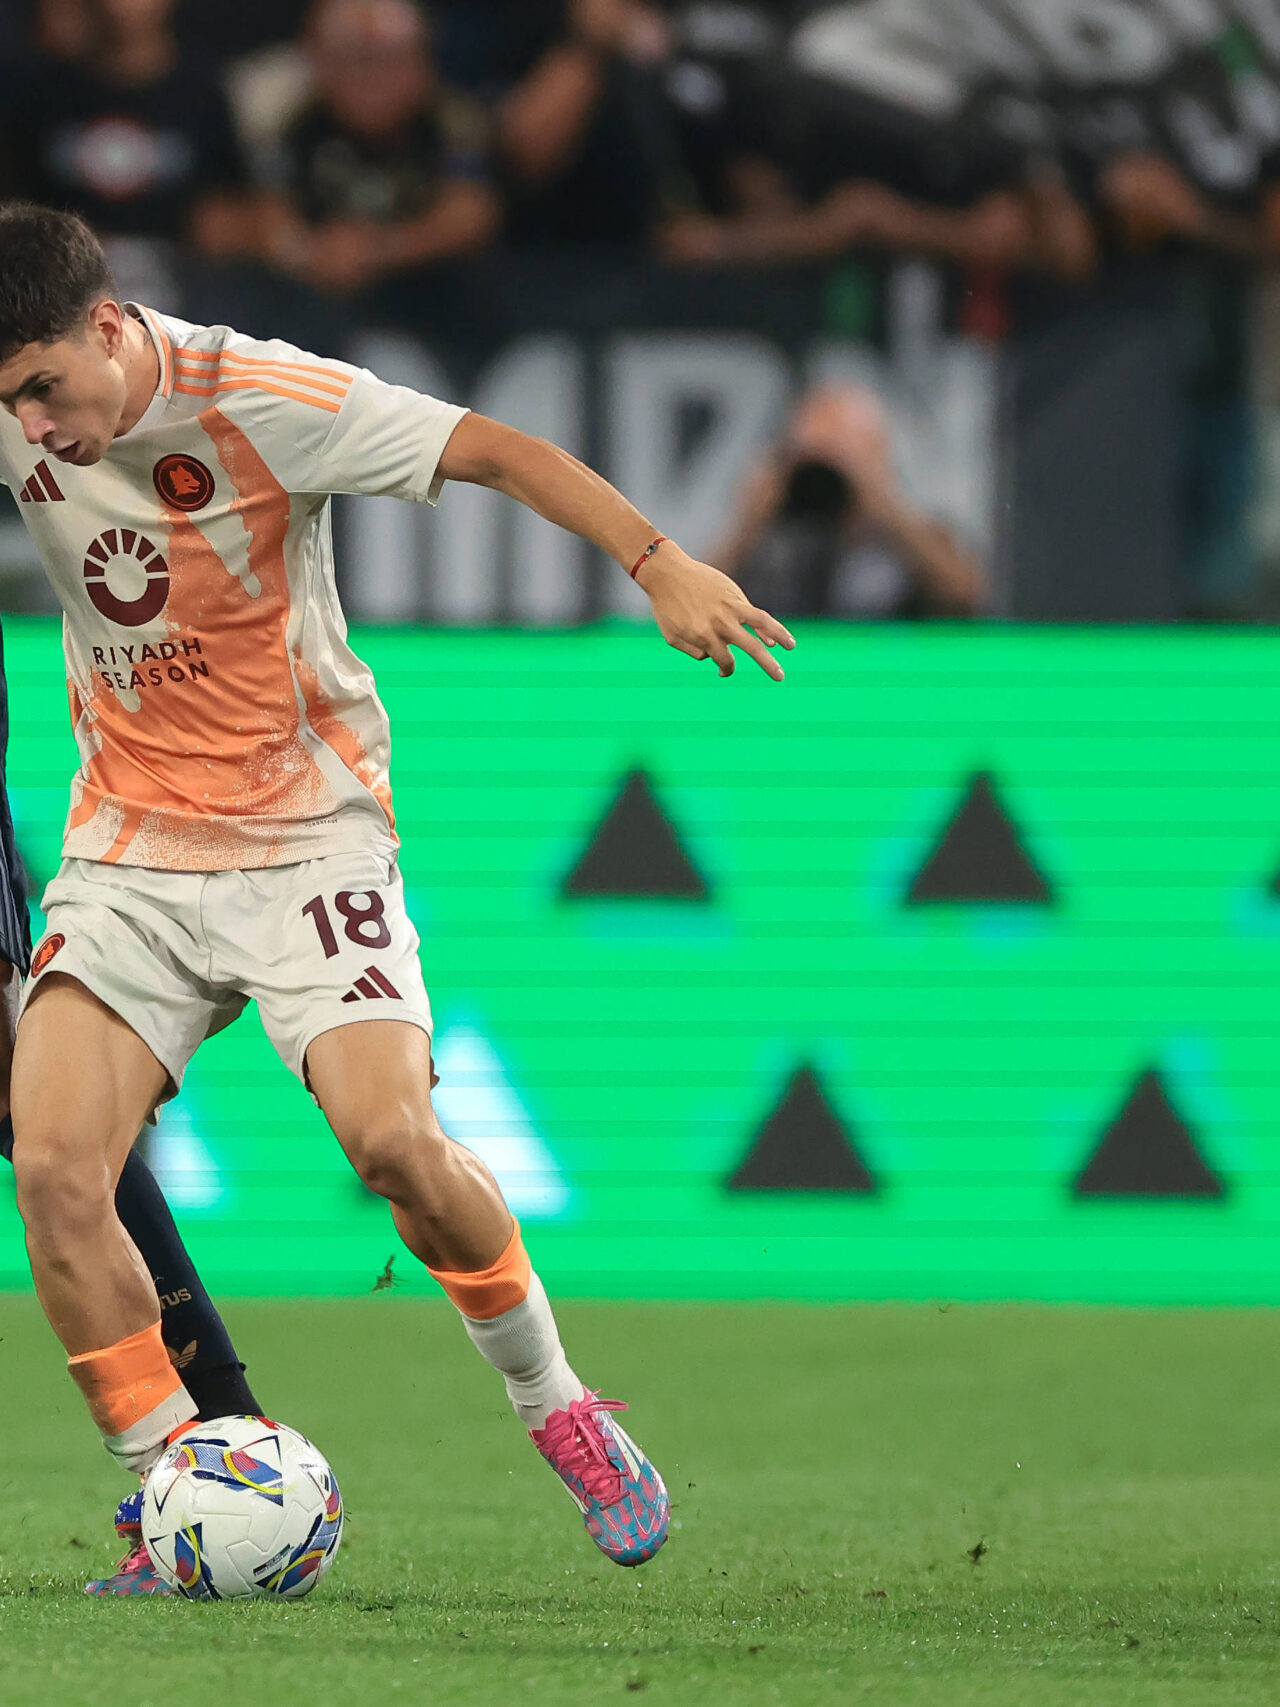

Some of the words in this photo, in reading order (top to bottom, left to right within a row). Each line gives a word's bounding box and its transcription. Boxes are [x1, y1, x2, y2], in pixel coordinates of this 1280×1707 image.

[92, 637, 203, 666] RIYADH
[101, 660, 210, 690] SEASON
[302, 890, 392, 960] 18
